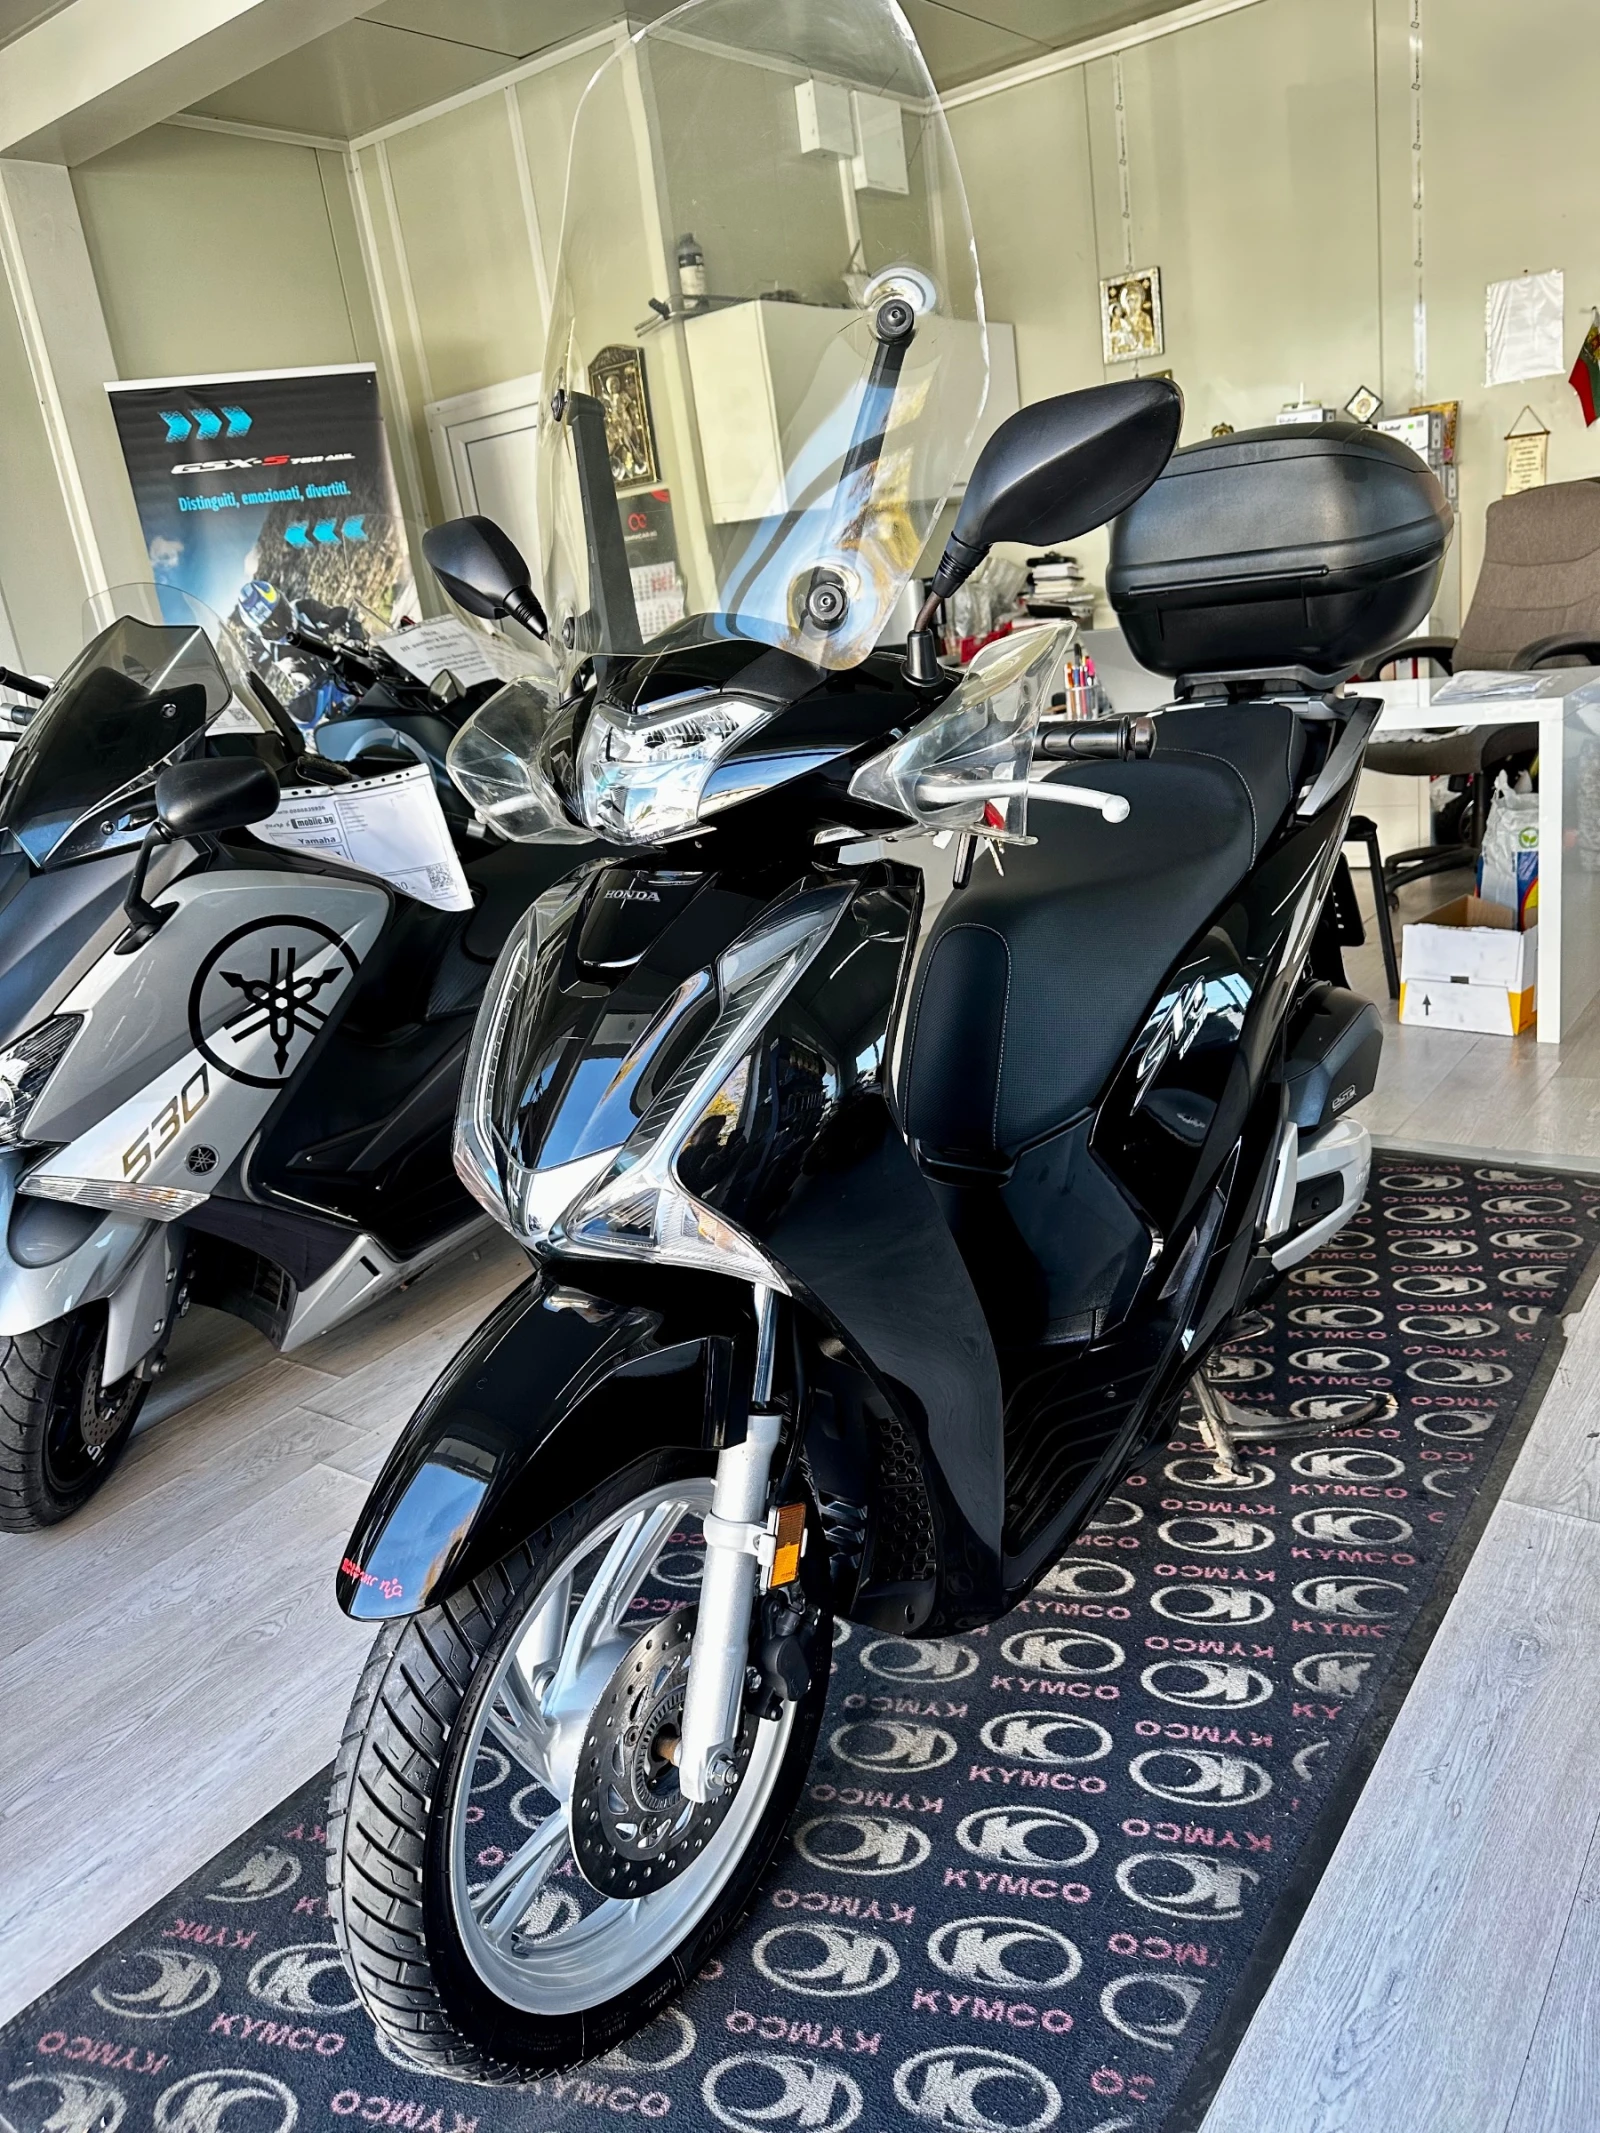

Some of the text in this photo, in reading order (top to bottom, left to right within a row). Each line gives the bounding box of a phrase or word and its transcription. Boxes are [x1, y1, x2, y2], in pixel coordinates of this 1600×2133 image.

[171, 455, 290, 474] GSX-S
[178, 480, 351, 512] Distinguiti, emozionati, divertiti.
[296, 816, 334, 826] mobile.bg
[298, 836, 336, 844] Yamaha
[604, 890, 660, 902] HONDA
[122, 1063, 210, 1182] 530
[1477, 1183, 1564, 1192] KYMCO
[1382, 1196, 1469, 1204] KYMCO
[1484, 1216, 1576, 1224] KYMCO
[1386, 1229, 1476, 1237] KYMCO
[1390, 1264, 1484, 1273] KYMCO
[1288, 1290, 1381, 1298] KYMCO
[1396, 1302, 1494, 1312] KYMCO
[1288, 1331, 1387, 1340] KYMCO
[1403, 1346, 1508, 1356] KYMCO
[1288, 1376, 1392, 1386] KYMCO
[1290, 1484, 1408, 1498] KYMCO
[1160, 1498, 1276, 1515] KYMCO
[1290, 1547, 1416, 1566] KYMCO
[1154, 1564, 1276, 1582] KYMCO
[1145, 1636, 1274, 1658] KYMCO
[990, 1674, 1120, 1700] KYMCO
[843, 1694, 968, 1718] KYMCO
[1135, 1720, 1272, 1748] KYMCO
[968, 1765, 1107, 1794] KYMCO
[811, 1784, 944, 1814] KYMCO
[1121, 1818, 1272, 1852] KYMCO
[944, 1868, 1092, 1904] KYMCO
[772, 1888, 916, 1924] KYMCO
[912, 1988, 1074, 2034] KYMCO
[209, 2012, 346, 2056] KYMCO
[725, 2010, 882, 2054] KYMCO
[38, 2030, 168, 2076] KYMCO
